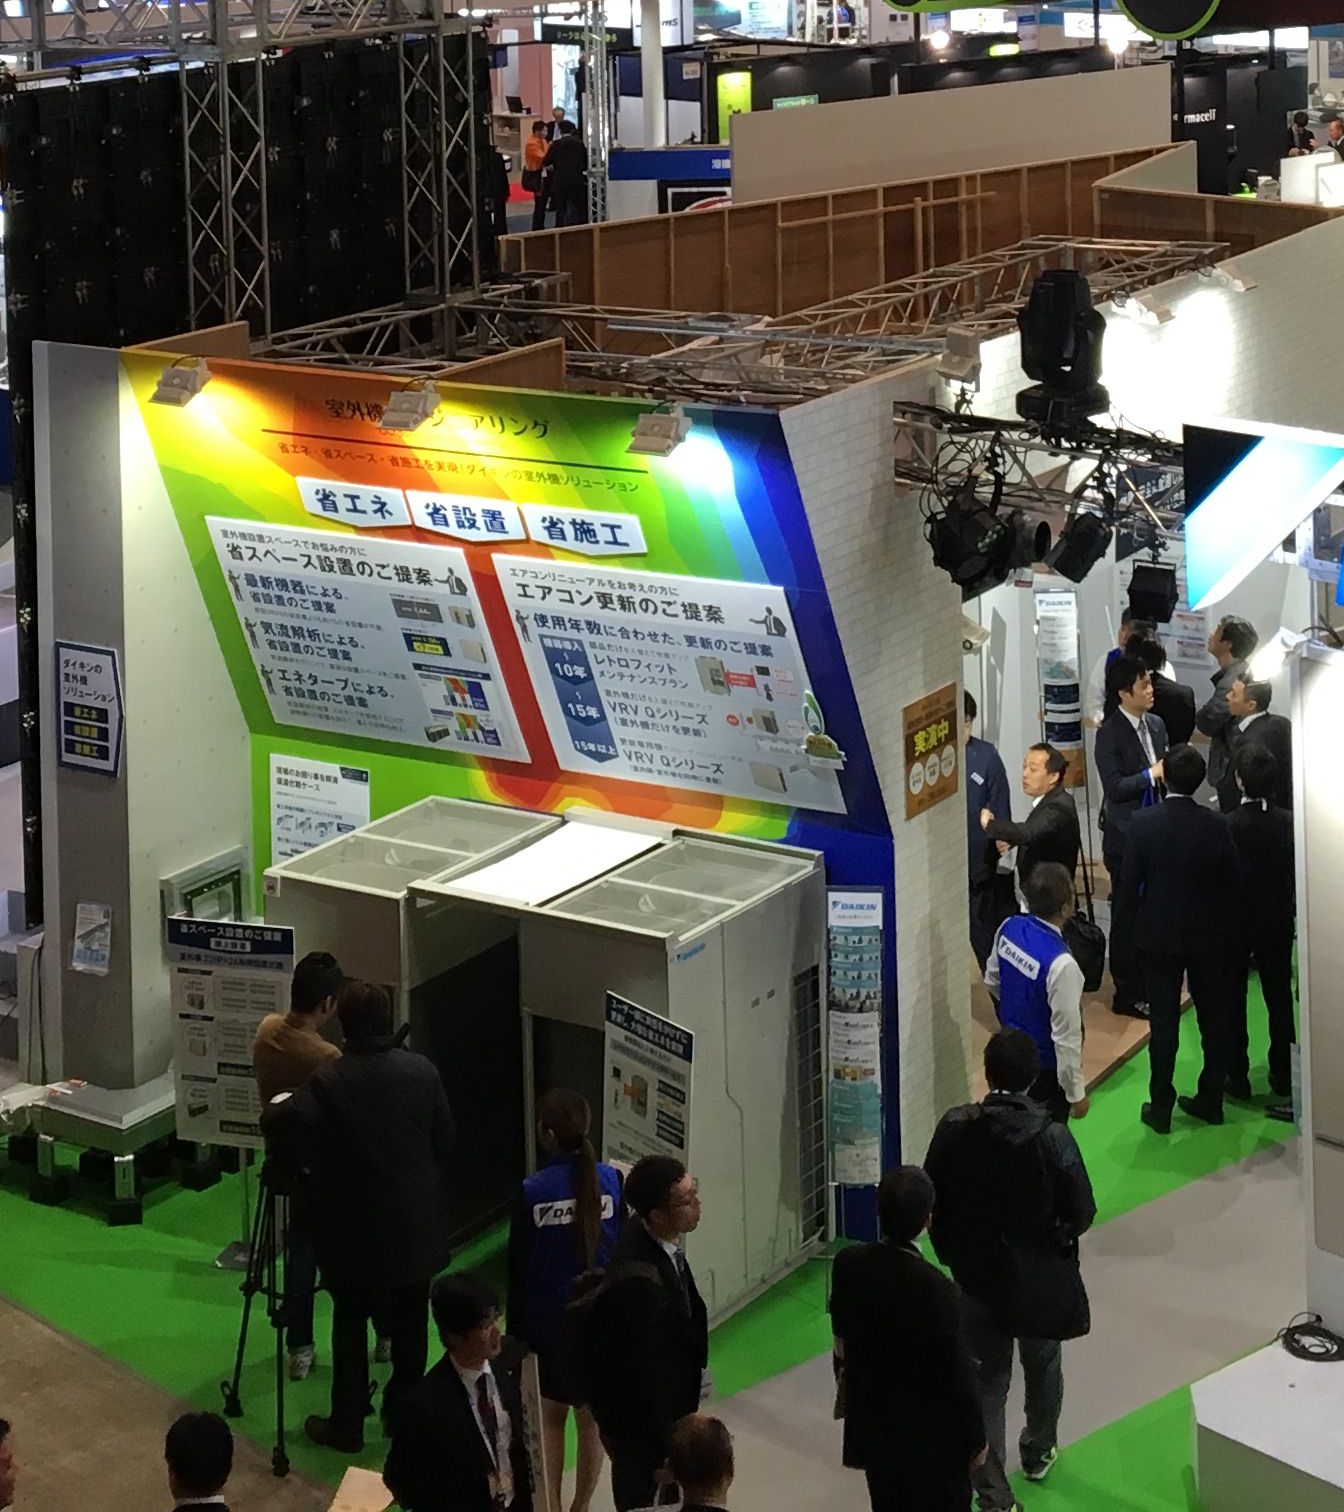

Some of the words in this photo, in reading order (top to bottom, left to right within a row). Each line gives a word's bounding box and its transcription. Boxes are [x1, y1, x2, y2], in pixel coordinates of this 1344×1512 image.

[1183, 109, 1216, 124] rmacell
[314, 488, 394, 520] 省エネ
[424, 502, 510, 536] 省設置
[541, 515, 631, 548] 省施工
[226, 542, 434, 587] 省スペース設置のご提案
[509, 567, 681, 597] エアコンリニューアルをお考えの方に
[248, 590, 337, 614] 省設置のご提案
[515, 581, 726, 625] エアコン更新のご提案
[533, 612, 774, 659] 使用年数に合わせた、更新のご提案
[63, 657, 103, 675] ダイキンの
[554, 662, 588, 679] 10年
[593, 653, 678, 676] レトロフィット
[598, 670, 689, 690] メンテナンスプラン
[63, 685, 115, 704] ソリューション
[567, 702, 601, 719] 15年
[606, 700, 639, 717] VRV
[645, 705, 710, 726] Qシリーズ
[573, 739, 618, 756] 15年以上
[914, 718, 949, 756] 実演中
[623, 749, 654, 765] VRV
[660, 754, 726, 776] Qシリーズ
[841, 903, 877, 911] DAIKIN
[1005, 945, 1035, 973] DAIKIN
